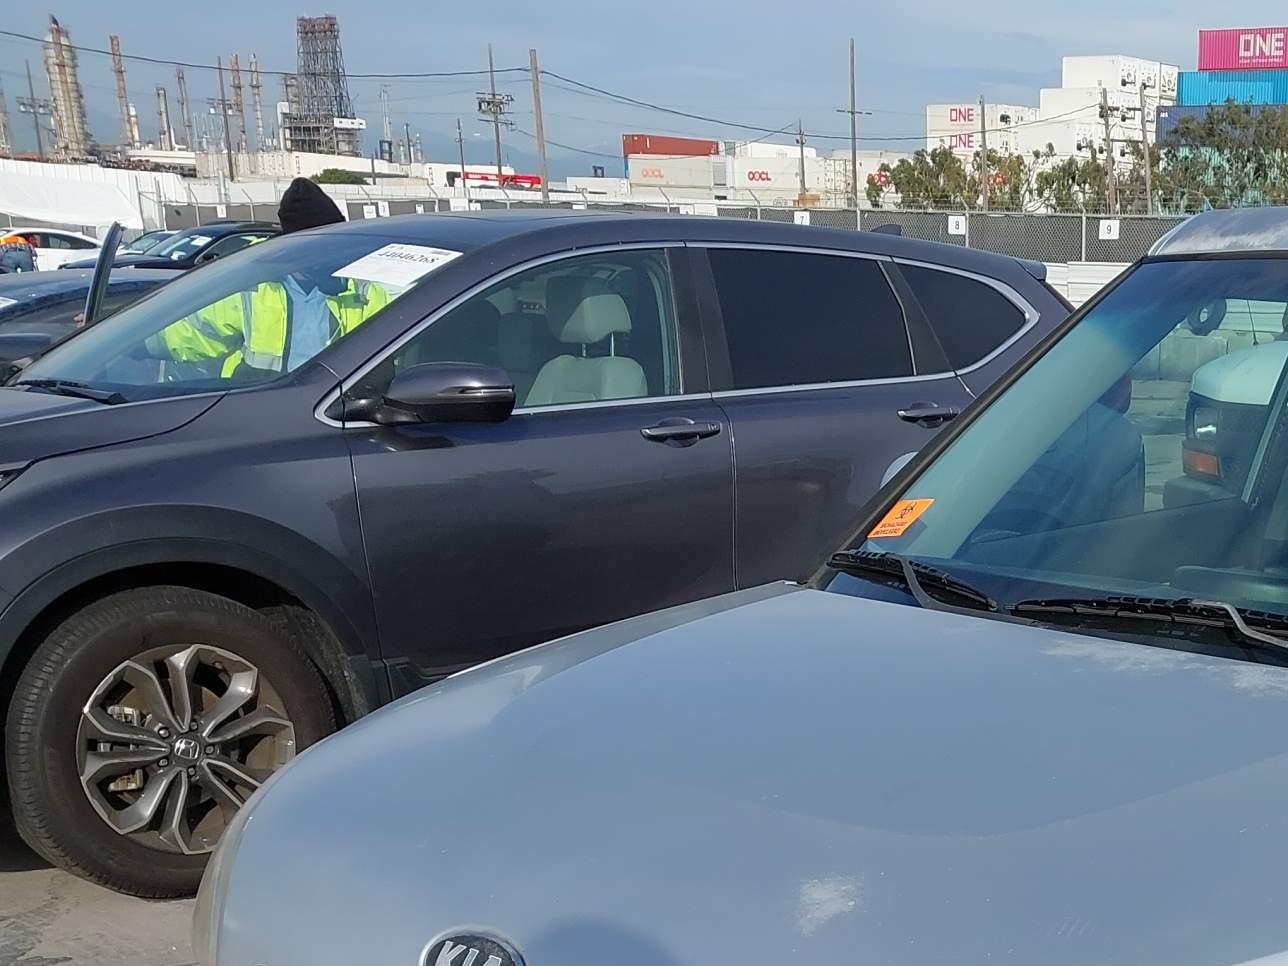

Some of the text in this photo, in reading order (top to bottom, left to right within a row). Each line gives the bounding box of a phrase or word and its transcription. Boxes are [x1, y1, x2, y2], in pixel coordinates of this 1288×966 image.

[1239, 33, 1284, 56] ONE
[950, 108, 974, 121] ONE
[950, 134, 974, 148] ONE
[641, 168, 664, 179] OOCL
[747, 171, 771, 181] OOCL
[954, 220, 960, 230] 8
[1106, 224, 1112, 235] 9
